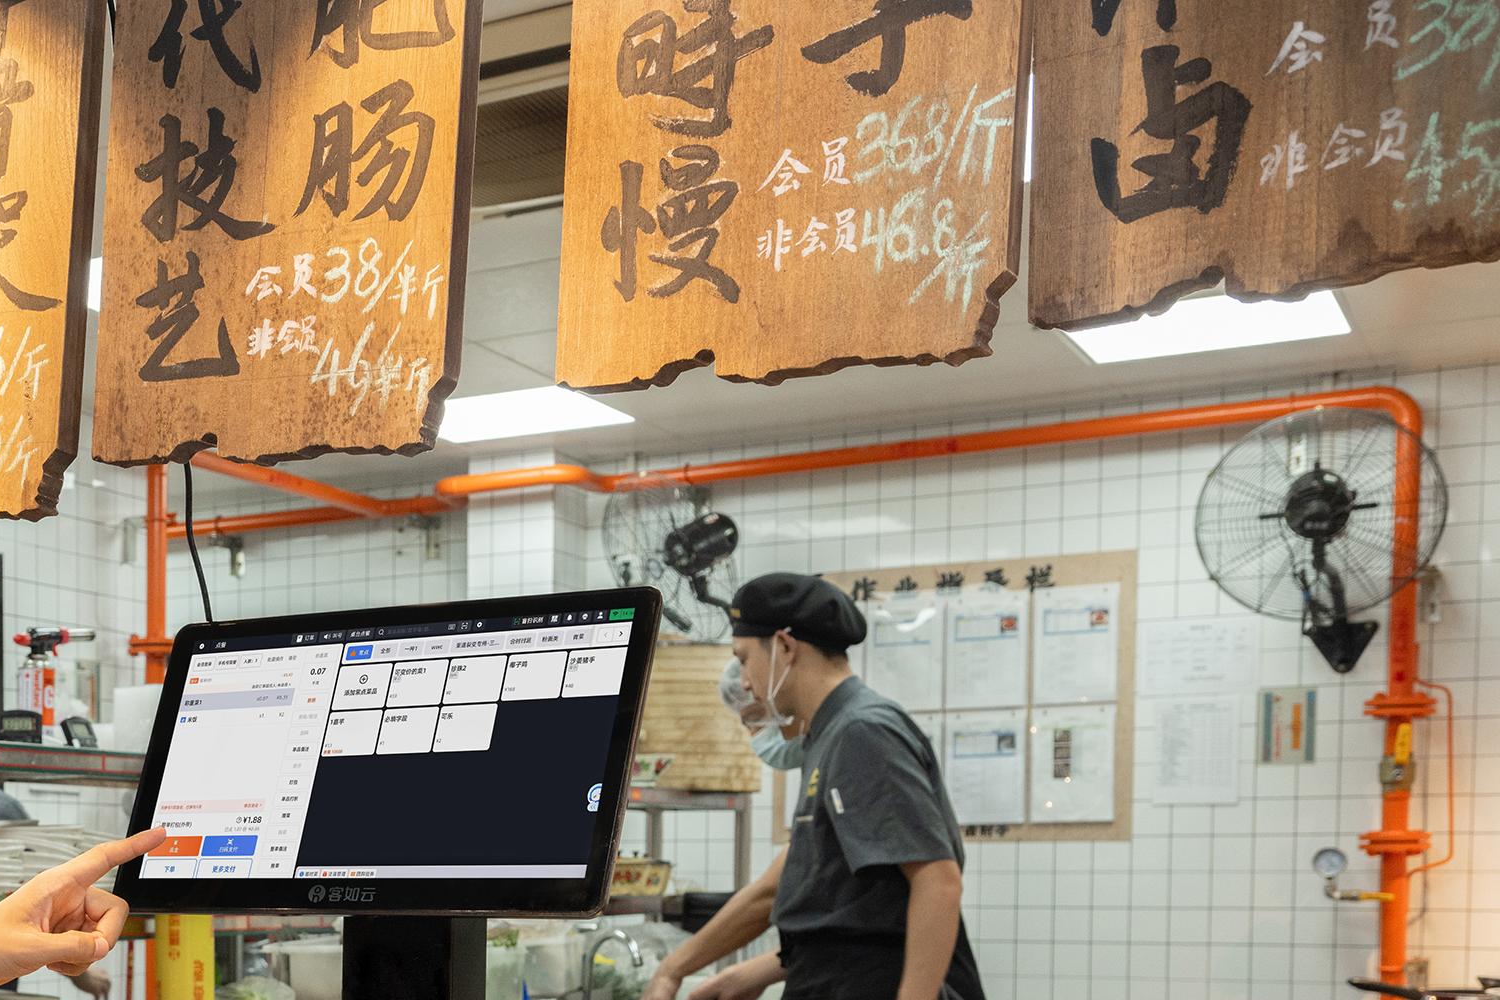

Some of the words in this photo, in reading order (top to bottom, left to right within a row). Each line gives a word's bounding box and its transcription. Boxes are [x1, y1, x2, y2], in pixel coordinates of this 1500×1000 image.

[1090, 0, 1254, 224] 卤
[309, 667, 327, 676] 0.07
[242, 815, 263, 825] ¥1.88
[211, 864, 237, 874] 更多支付
[328, 886, 377, 902] 客如云
